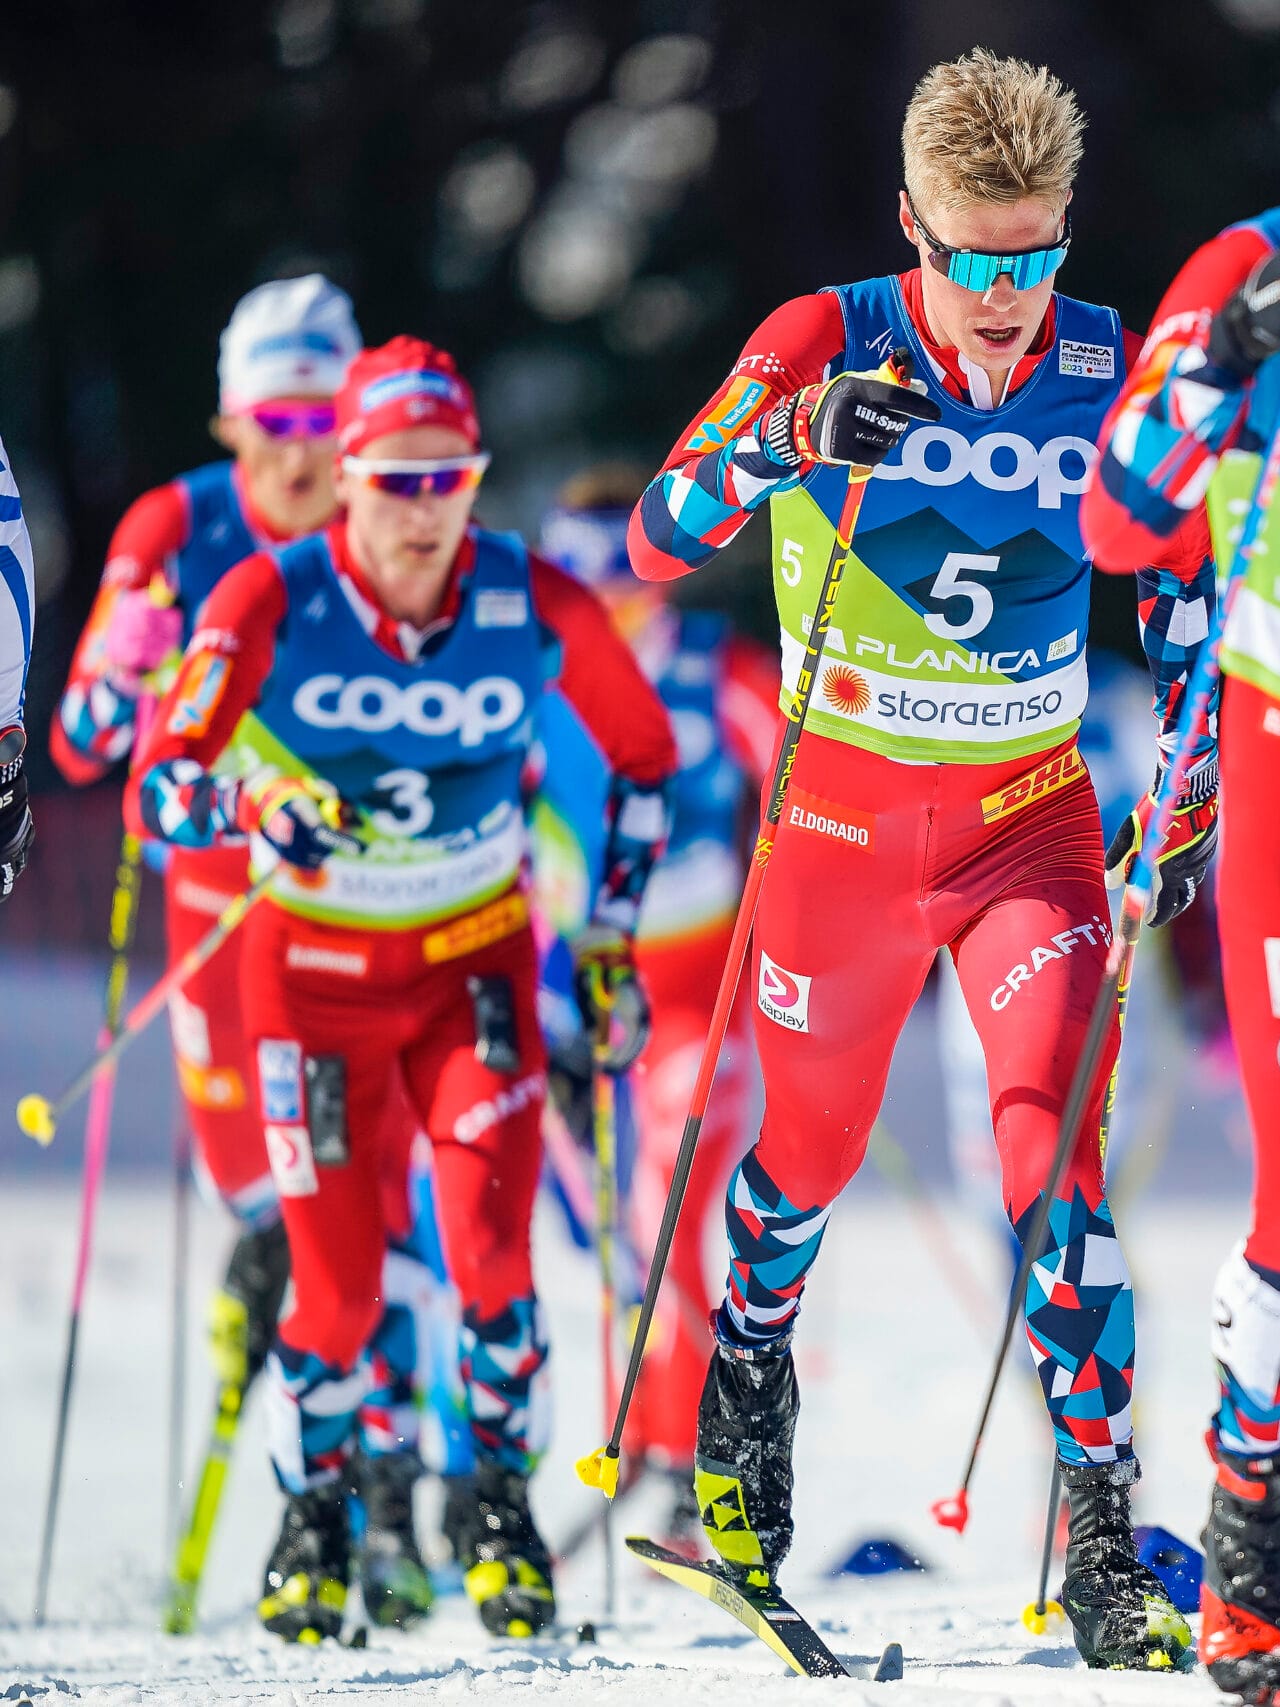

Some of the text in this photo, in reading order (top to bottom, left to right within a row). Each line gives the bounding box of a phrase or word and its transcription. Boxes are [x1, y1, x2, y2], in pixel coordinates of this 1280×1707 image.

[1061, 364, 1083, 375] 2023
[1062, 342, 1112, 356] PLANICA
[723, 387, 759, 425] NorEngros
[781, 539, 804, 588] 5
[923, 553, 1000, 640] 5
[855, 635, 1041, 674] PLANICA
[292, 674, 524, 747] coop
[878, 690, 1062, 726] storaenso
[371, 768, 435, 836] 3
[1001, 753, 1080, 812] DHL
[789, 804, 869, 847] ELDORADO
[990, 923, 1098, 1012] CRAFT
[759, 994, 806, 1030] viaplay
[715, 1583, 744, 1619] FISCHER
